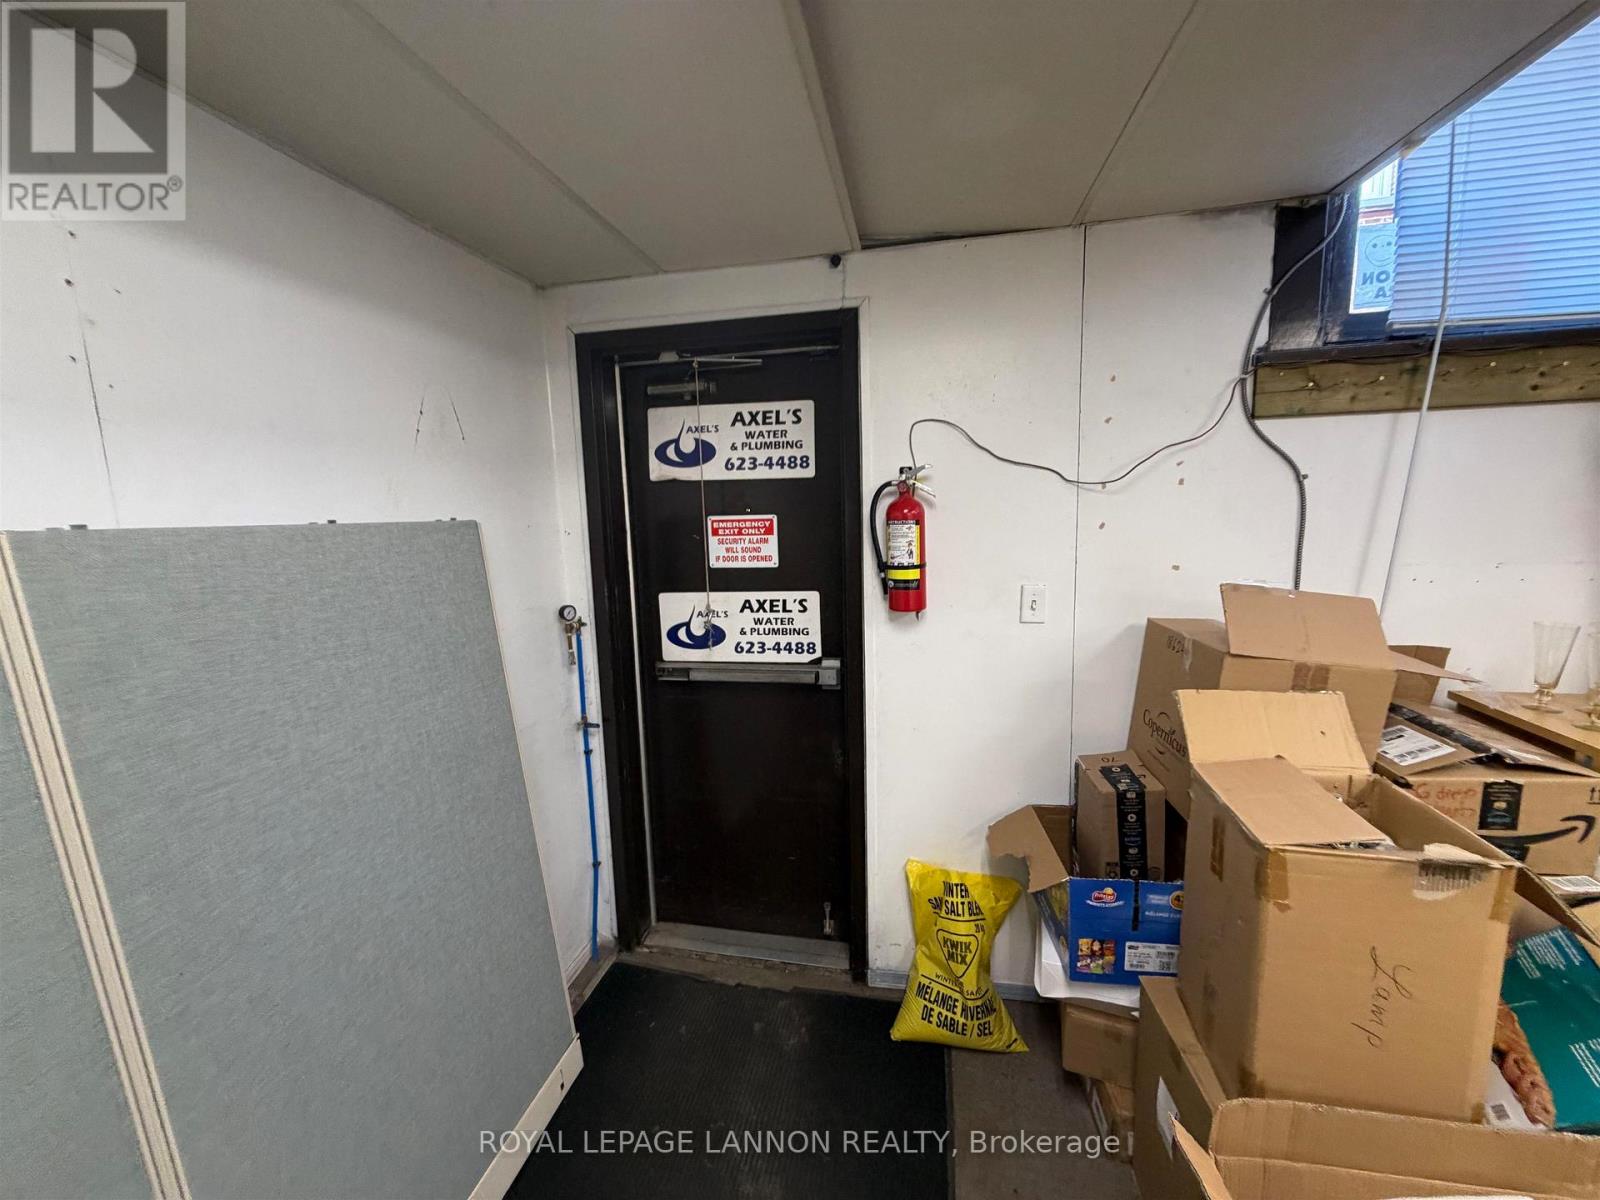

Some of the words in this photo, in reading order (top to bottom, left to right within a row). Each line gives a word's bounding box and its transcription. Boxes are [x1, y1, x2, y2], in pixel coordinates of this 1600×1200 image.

[730, 408, 802, 427] AXEL'S
[686, 424, 719, 434] AXEL'S
[745, 429, 788, 440] WATER
[730, 442, 738, 451] &
[741, 440, 804, 451] PLUMBING
[724, 455, 810, 471] 623-4488
[713, 520, 771, 529] EMERGENCY
[717, 537, 747, 545] SECURITY
[748, 537, 769, 545] ALARM
[725, 546, 739, 554] WILL
[741, 546, 762, 554] SOUND
[715, 555, 721, 563] IF
[722, 555, 739, 563] DOOR
[740, 555, 747, 563] IS
[748, 555, 773, 563] OPENED
[739, 598, 808, 614] AXEL'S
[753, 617, 795, 626] WATER
[739, 627, 747, 636] &
[750, 627, 810, 636] PLUMBING
[734, 641, 817, 655] 623-4488
[944, 899, 966, 917] SALT
[943, 936, 972, 954] KWIK
[947, 949, 968, 966] MIX
[916, 981, 960, 1015] MÉLANGE
[921, 1004, 935, 1025] DE
[935, 1011, 968, 1036] SABLE
[969, 1023, 975, 1038] /
[977, 1020, 993, 1038] SEL
